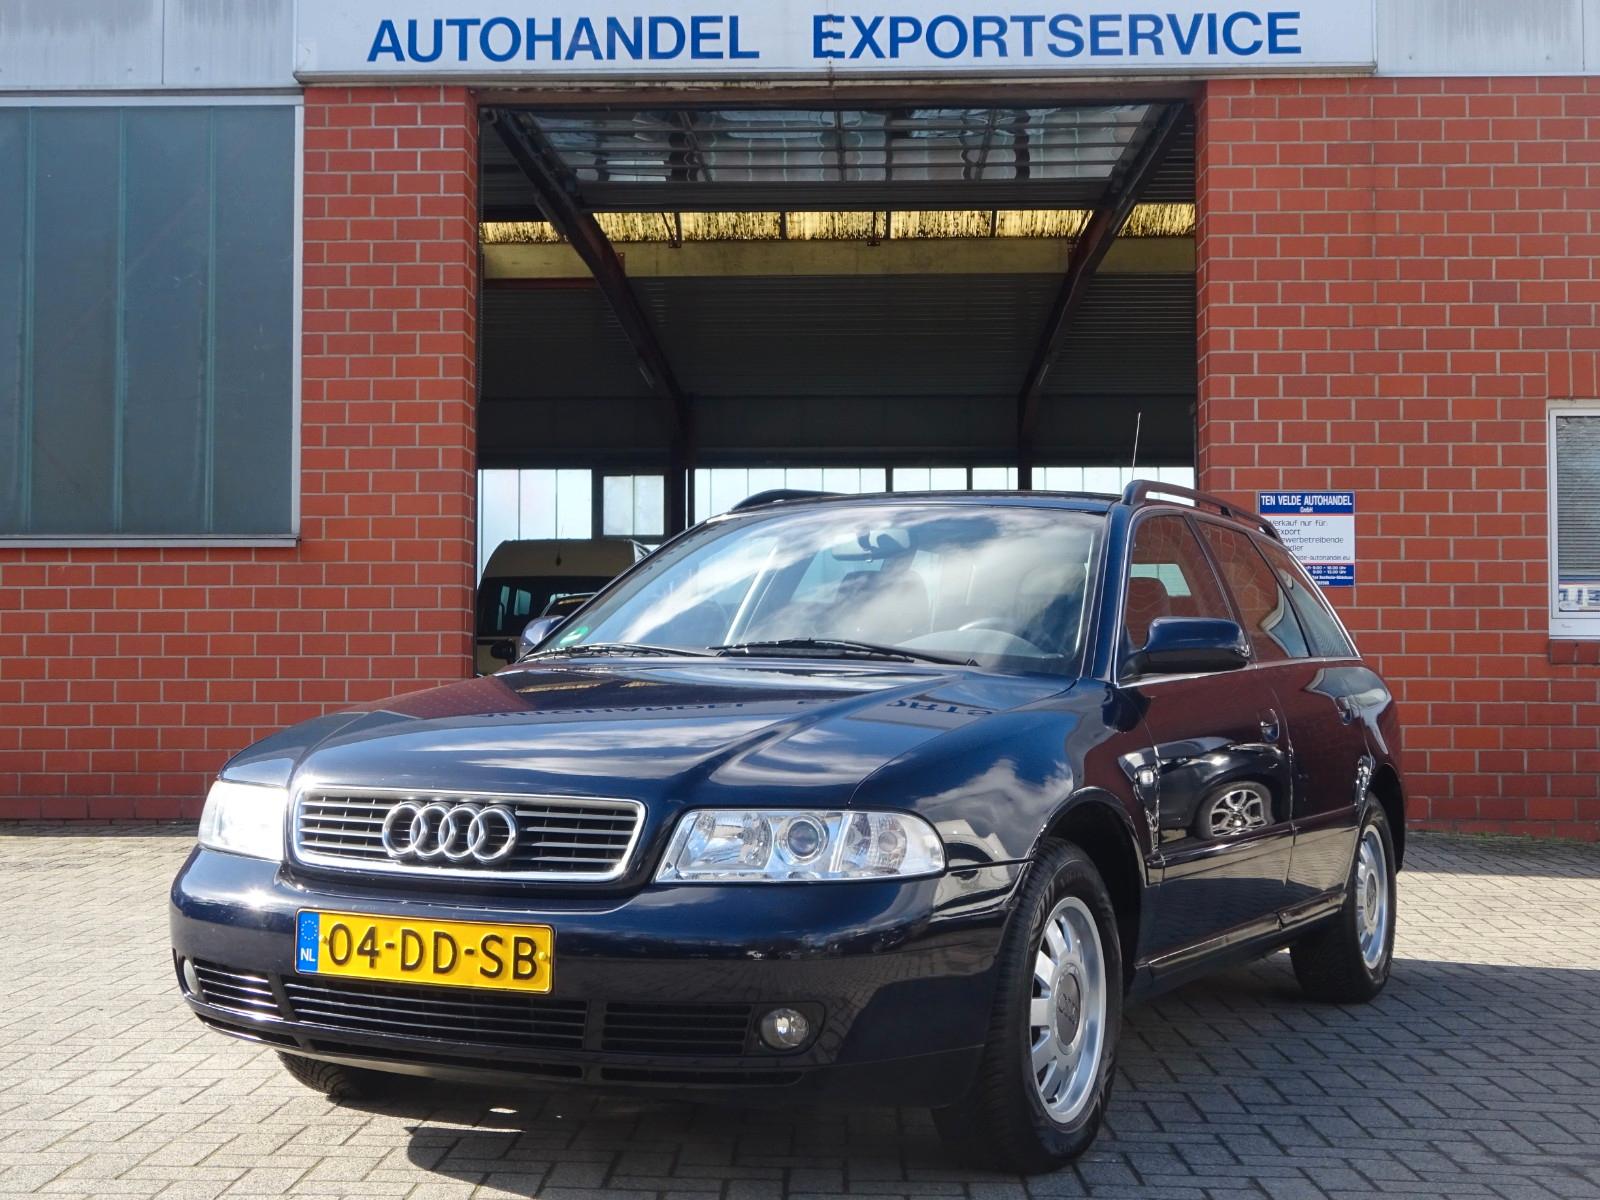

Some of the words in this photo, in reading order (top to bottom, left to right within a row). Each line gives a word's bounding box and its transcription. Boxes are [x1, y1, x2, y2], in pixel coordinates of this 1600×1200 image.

[367, 15, 760, 63] AUTOHANDEL
[813, 11, 1302, 59] EXPORTSERVICE
[1261, 495, 1275, 506] TEN
[1278, 495, 1302, 506] VELDE
[1304, 495, 1352, 506] AUTOHANDEL
[300, 948, 316, 962] NL
[328, 923, 538, 980] 04-DD-SB
